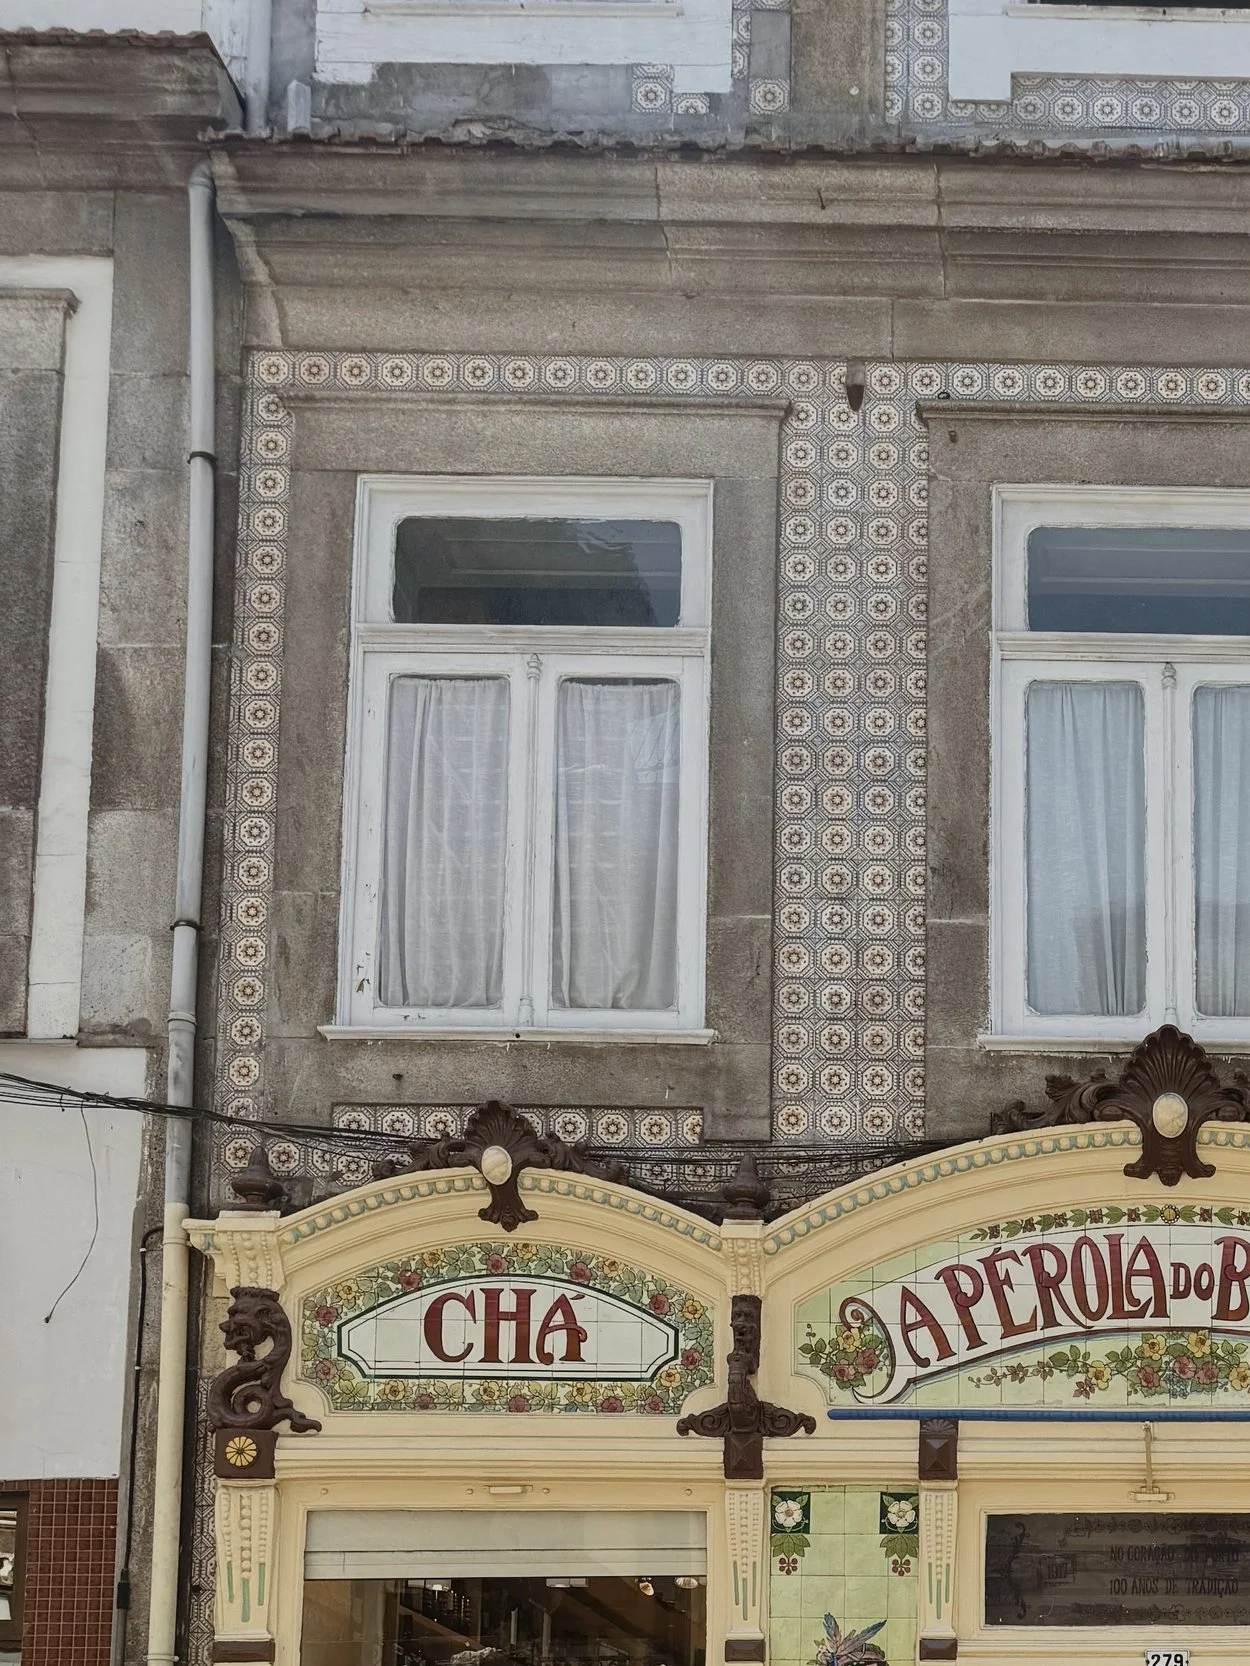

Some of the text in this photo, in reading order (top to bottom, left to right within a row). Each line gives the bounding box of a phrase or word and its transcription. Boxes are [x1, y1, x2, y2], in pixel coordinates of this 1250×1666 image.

[423, 1287, 588, 1366] CHÁ
[900, 1285, 953, 1368] A
[934, 1233, 1170, 1351] PÉROLA
[1169, 1261, 1215, 1299] DO
[1110, 1576, 1239, 1598] 100 ANOS DE TRADIÇÃO
